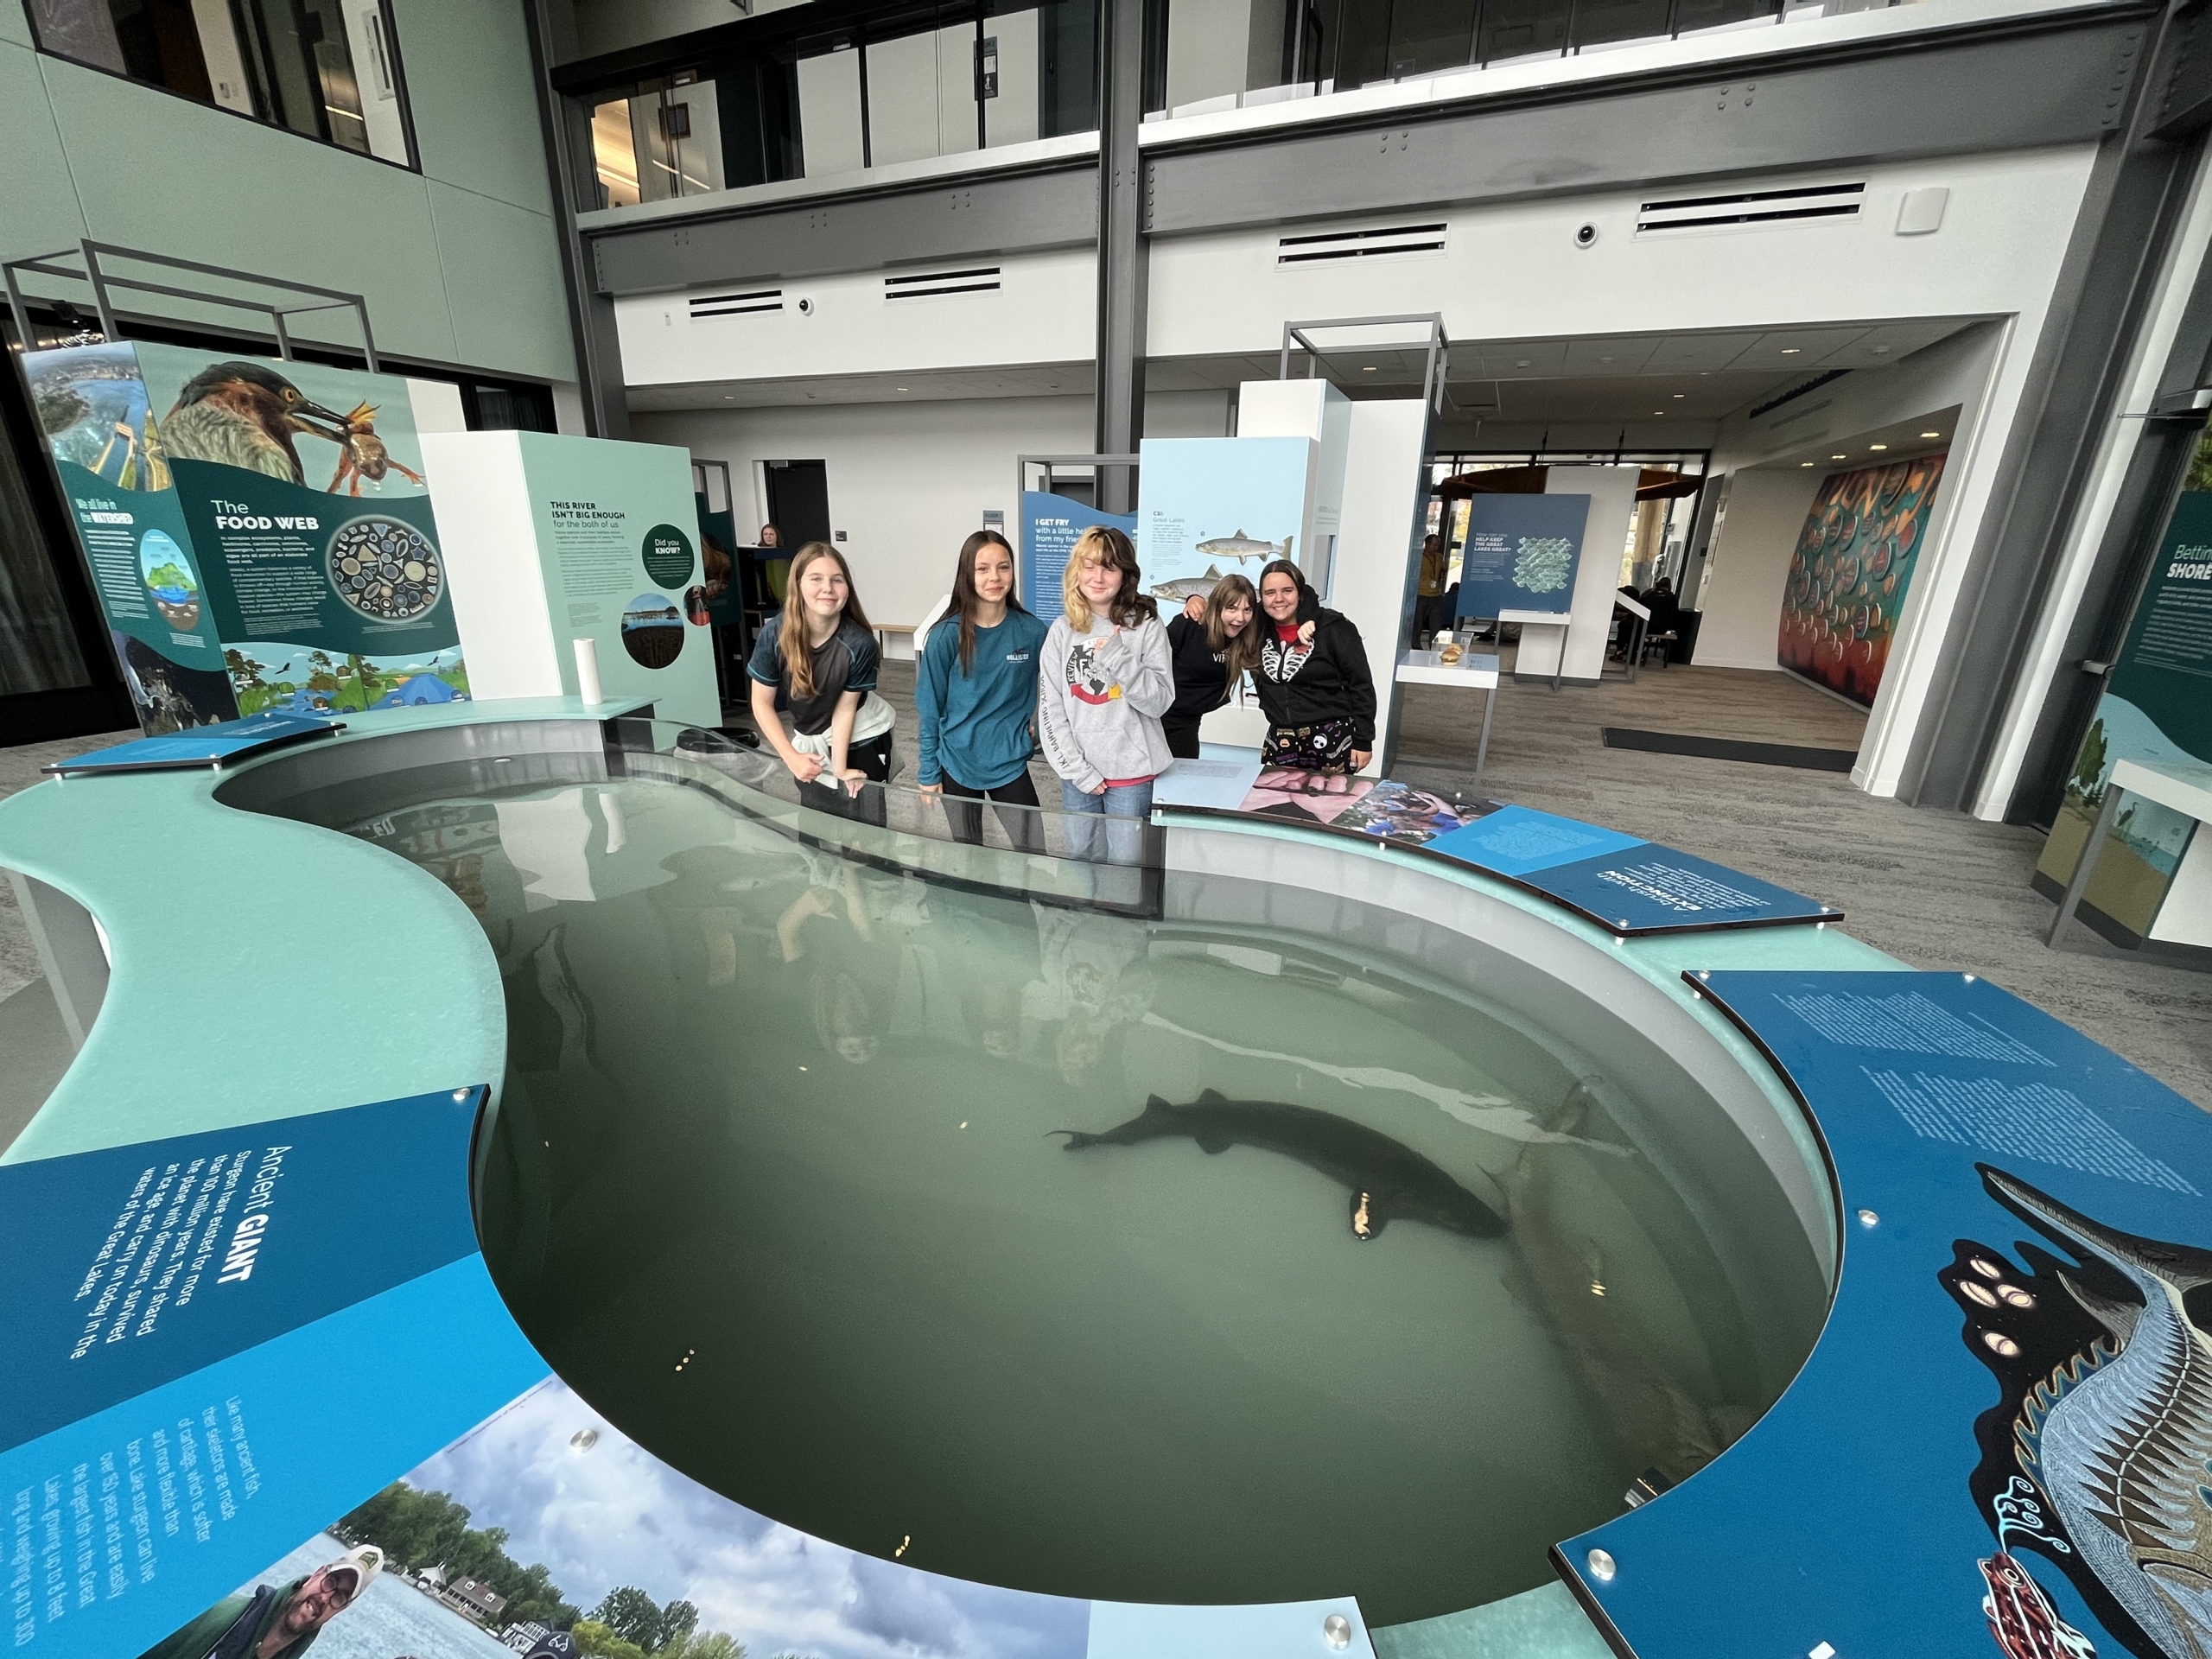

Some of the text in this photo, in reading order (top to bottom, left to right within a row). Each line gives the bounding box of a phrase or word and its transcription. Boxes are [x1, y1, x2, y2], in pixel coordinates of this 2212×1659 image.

[210, 500, 249, 514] The
[216, 516, 319, 530] FOOD WEB
[2174, 544, 2212, 561] Bettin
[2167, 563, 2212, 580] SHORE
[1068, 652, 1078, 682] REVIEW
[1597, 873, 1626, 887] with
[1605, 870, 1703, 911] EXTINCTION
[1628, 886, 1673, 906] brush
[70, 1163, 180, 1360] an ice age, and carry on today in the
[73, 1166, 156, 1302] waters of the Great Lakes.
[106, 1158, 207, 1344] the planet with dinosaurs, survived
[136, 1154, 229, 1337] than 100 million years. They shared
[175, 1150, 251, 1306] Sturgeon have existed for more
[217, 1145, 293, 1284] Ancient GIANT
[153, 1428, 182, 1538] and more flexible than
[178, 1418, 213, 1543] of cartilage, which is softer
[202, 1405, 238, 1521] their skeletons are made
[226, 1395, 262, 1500] Like many ancient fish,
[10, 1485, 35, 1647] long and weighing up to 300
[41, 1474, 69, 1624] Lakes, growing up to 8 feet
[70, 1462, 97, 1609] the largest fish in the Great
[99, 1452, 130, 1599] over 150 years and are easily
[127, 1437, 158, 1584] bone. Lake sturgeon can live
